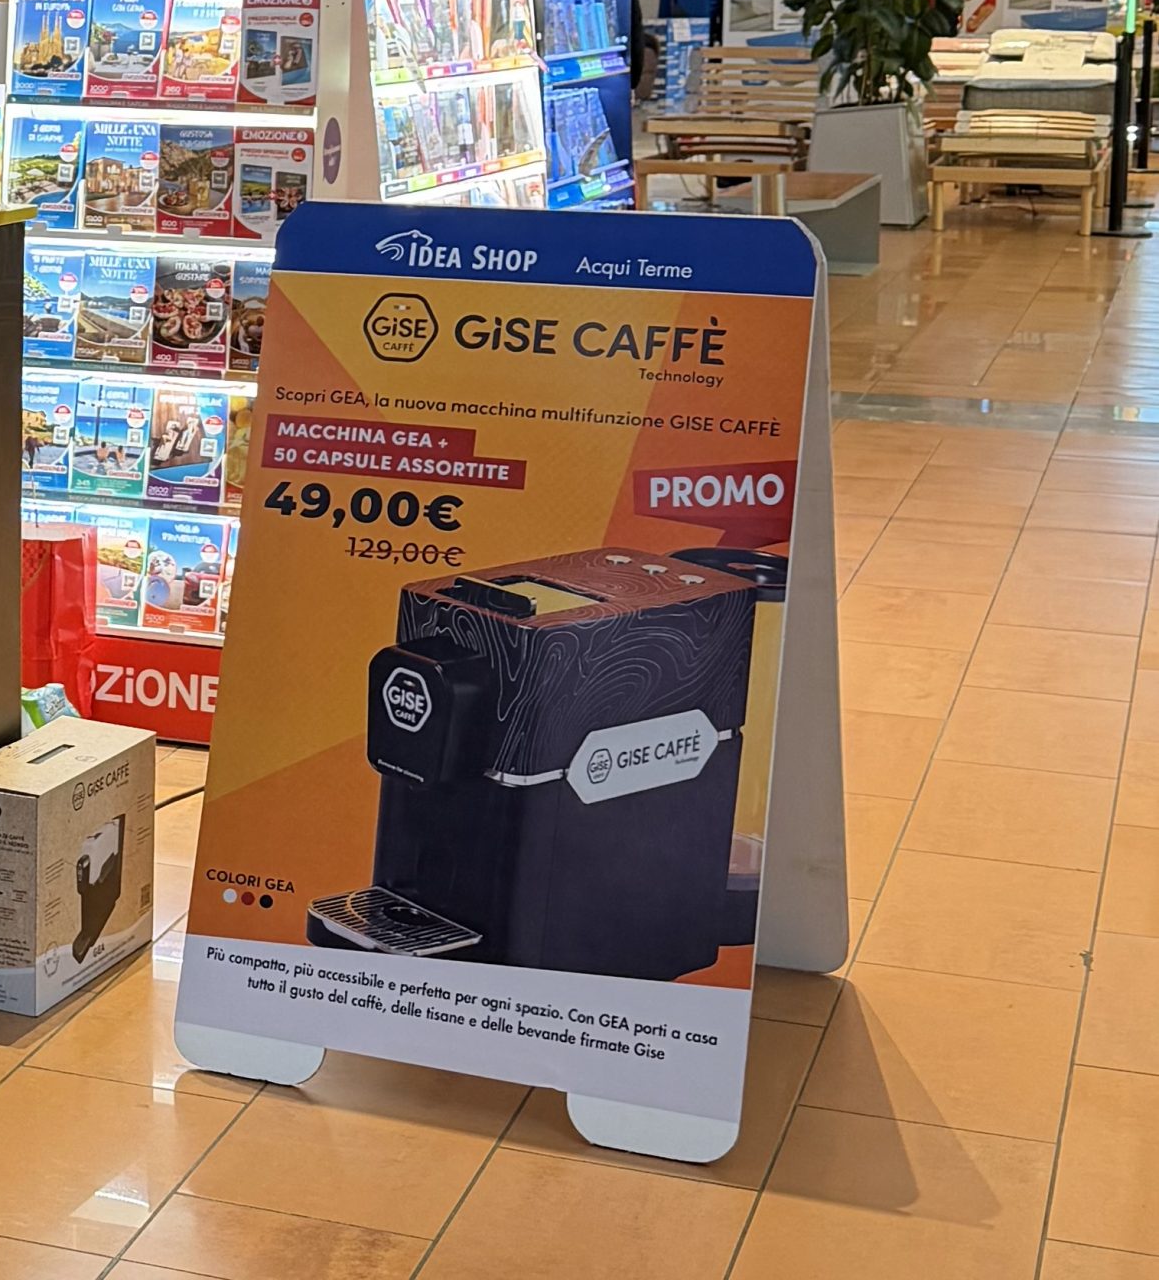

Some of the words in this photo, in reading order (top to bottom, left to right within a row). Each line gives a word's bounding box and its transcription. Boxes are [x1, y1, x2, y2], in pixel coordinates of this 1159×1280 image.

[93, 123, 127, 135] MILLE
[133, 124, 157, 136] UNA
[107, 135, 143, 147] NOTTE
[89, 255, 122, 267] MILLE
[128, 257, 151, 269] UNA
[175, 263, 200, 271] ITALIA
[408, 241, 462, 269] IDEA
[471, 245, 538, 272] SHOP
[576, 257, 631, 280] Acqui
[638, 259, 693, 279] Terme
[101, 269, 138, 280] NOTTE
[573, 316, 727, 365] CAFFÈ
[639, 368, 724, 387] Technology
[275, 387, 325, 406] Scopri
[330, 391, 370, 408] GEA,
[374, 393, 390, 407] la
[395, 399, 446, 413] nuova
[451, 401, 536, 419] macchina
[541, 407, 664, 430] multifunzione
[670, 415, 713, 432] GISE
[720, 417, 781, 437] CAFFÈ
[277, 422, 386, 445] MACCHINA
[392, 431, 432, 448] GEA
[438, 438, 448, 449] +
[274, 448, 297, 463] 50
[303, 450, 391, 471] CAPSULE
[397, 458, 509, 481] ASSORTITE
[264, 481, 464, 531] 49,00€
[650, 473, 784, 509] PROMO
[345, 536, 466, 567] 129,00€
[654, 729, 701, 760] CAFFÈ
[206, 869, 261, 888] COLORI
[265, 879, 295, 893] GEA
[207, 947, 225, 961] Più
[229, 954, 290, 975] compatta,
[294, 963, 314, 978] più
[318, 968, 384, 989] accessibile
[388, 980, 396, 991] e
[400, 981, 450, 1001] perfetta
[455, 992, 478, 1007] per
[482, 997, 512, 1012] ogni
[515, 1001, 564, 1019] spazio.
[568, 1008, 594, 1025] Con
[598, 1014, 630, 1031] GEA
[633, 1022, 667, 1038] porti
[671, 1029, 681, 1040] a
[685, 1031, 718, 1046] casa
[247, 977, 275, 992] tutto
[279, 980, 286, 994] il
[290, 984, 324, 1001] gusto
[328, 988, 348, 1005] del
[352, 995, 387, 1013] caffè,
[391, 1000, 422, 1018] delle
[426, 1004, 465, 1026] tisane
[469, 1016, 477, 1028] e
[481, 1015, 513, 1034] delle
[518, 1023, 576, 1045] bevande
[580, 1031, 629, 1055] firmate
[634, 1042, 665, 1060] Gise
